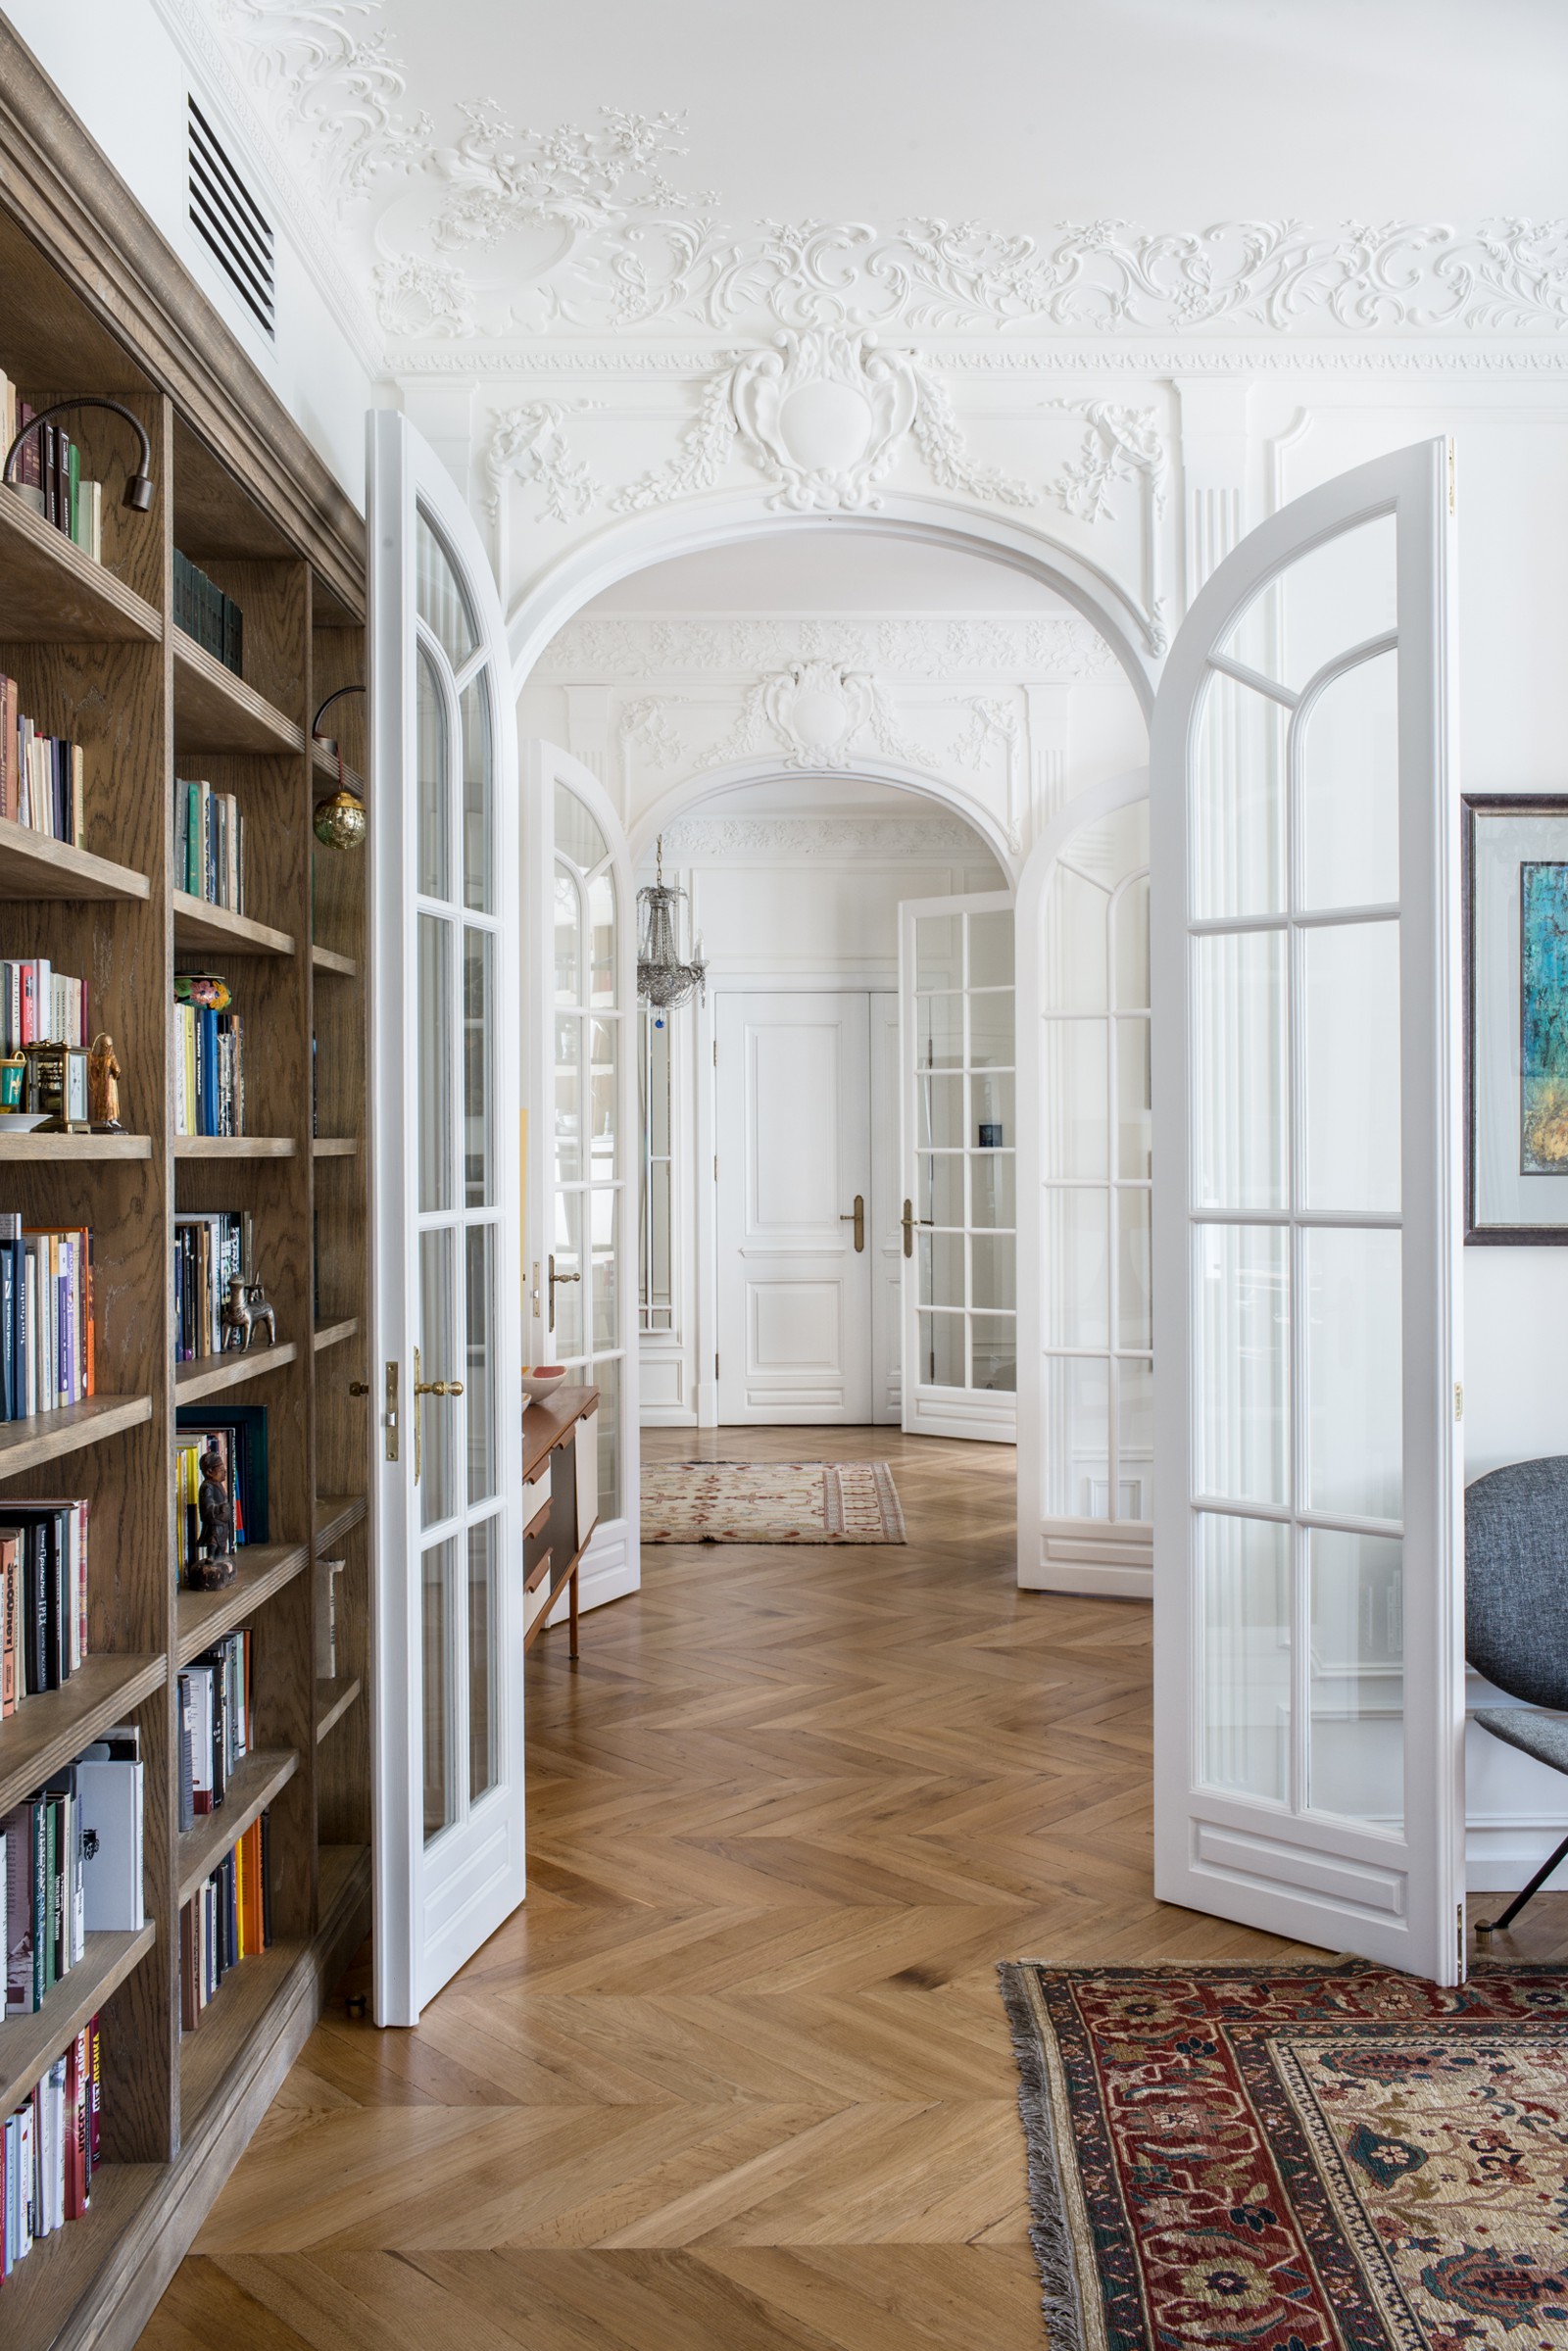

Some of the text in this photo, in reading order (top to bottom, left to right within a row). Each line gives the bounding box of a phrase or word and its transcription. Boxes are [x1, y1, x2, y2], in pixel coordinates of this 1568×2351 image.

[38, 1549, 47, 1598] Прилепин
[38, 1599, 47, 1627] ГРЕХ
[75, 2028, 85, 2105] ЧУБАЙСА
